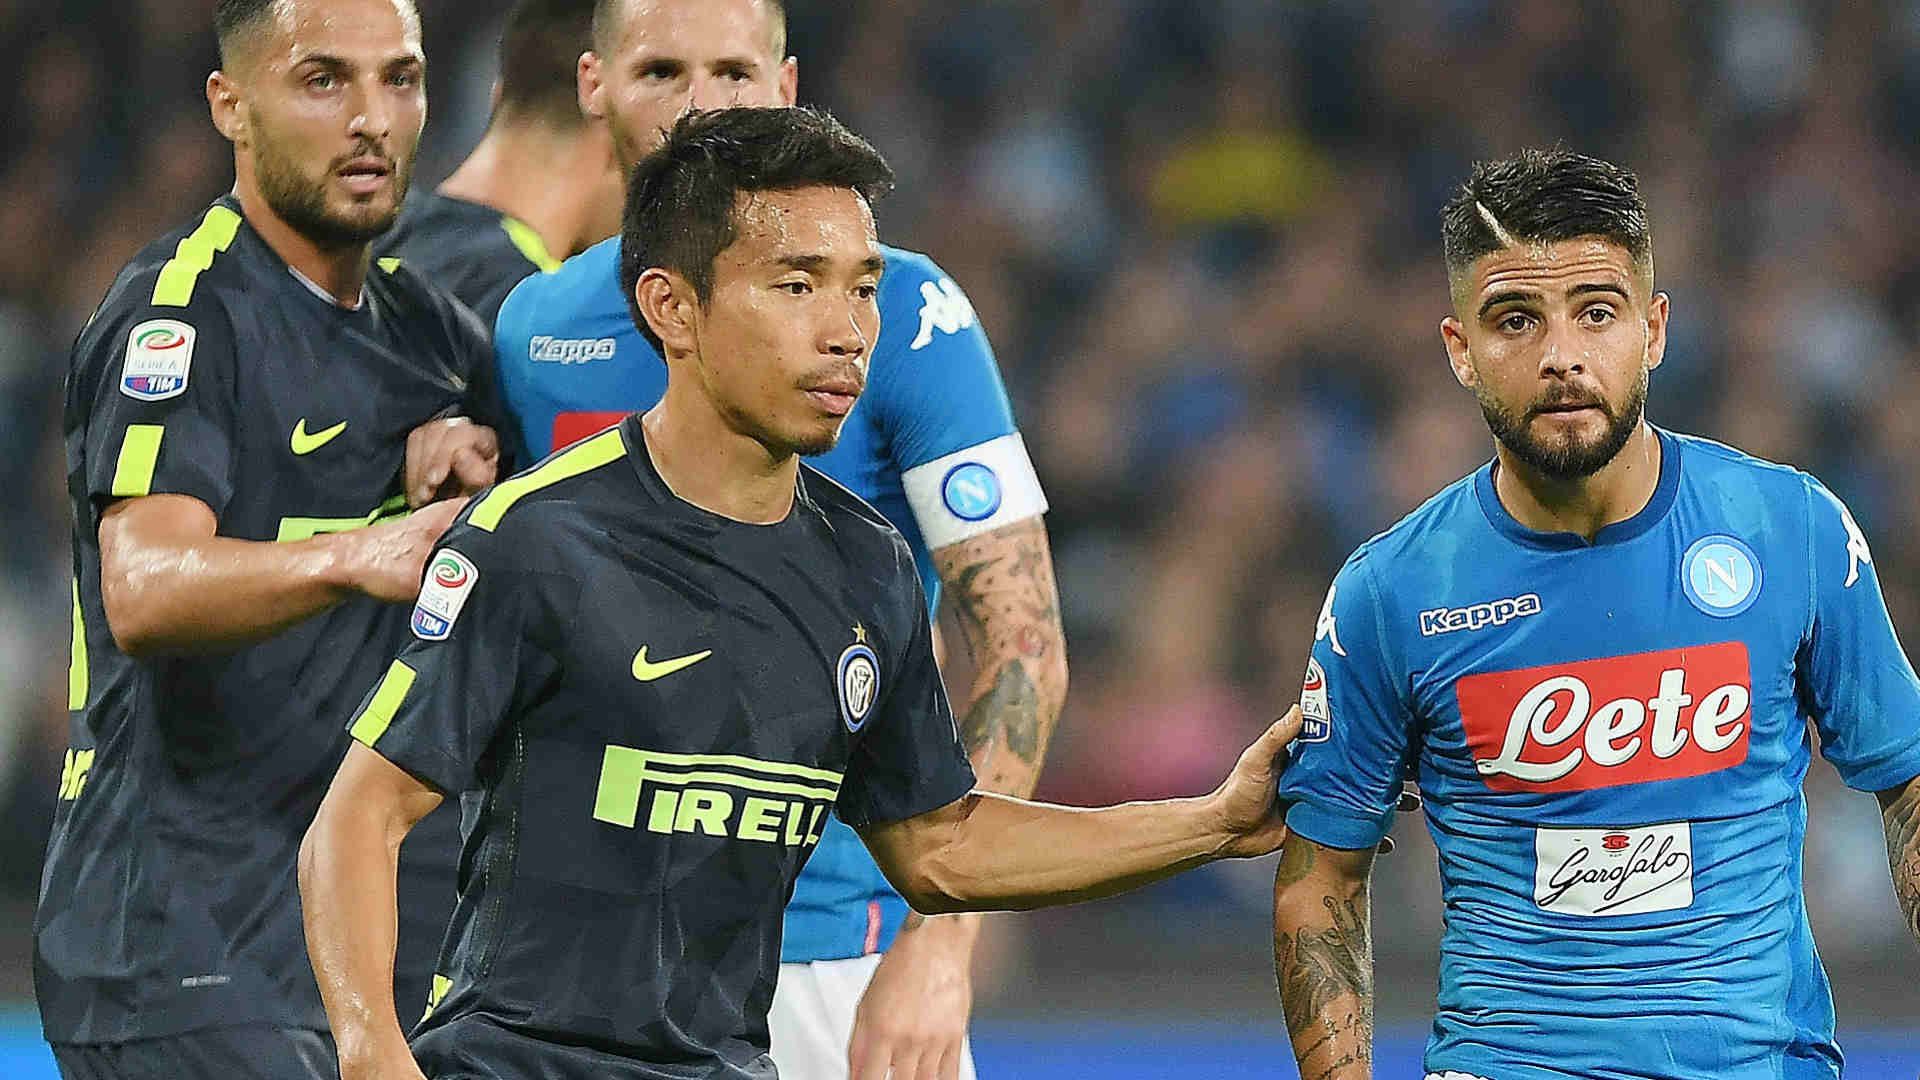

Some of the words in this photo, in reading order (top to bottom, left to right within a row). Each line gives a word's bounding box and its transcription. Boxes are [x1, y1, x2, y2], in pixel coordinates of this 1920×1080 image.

[529, 336, 616, 364] Kappa
[147, 376, 177, 393] TIM
[1701, 556, 1738, 594] N
[1420, 593, 1541, 635] Kappa
[1304, 720, 1321, 737] IM
[1476, 667, 1750, 783] Lete
[1537, 833, 1691, 914] Garofalo
